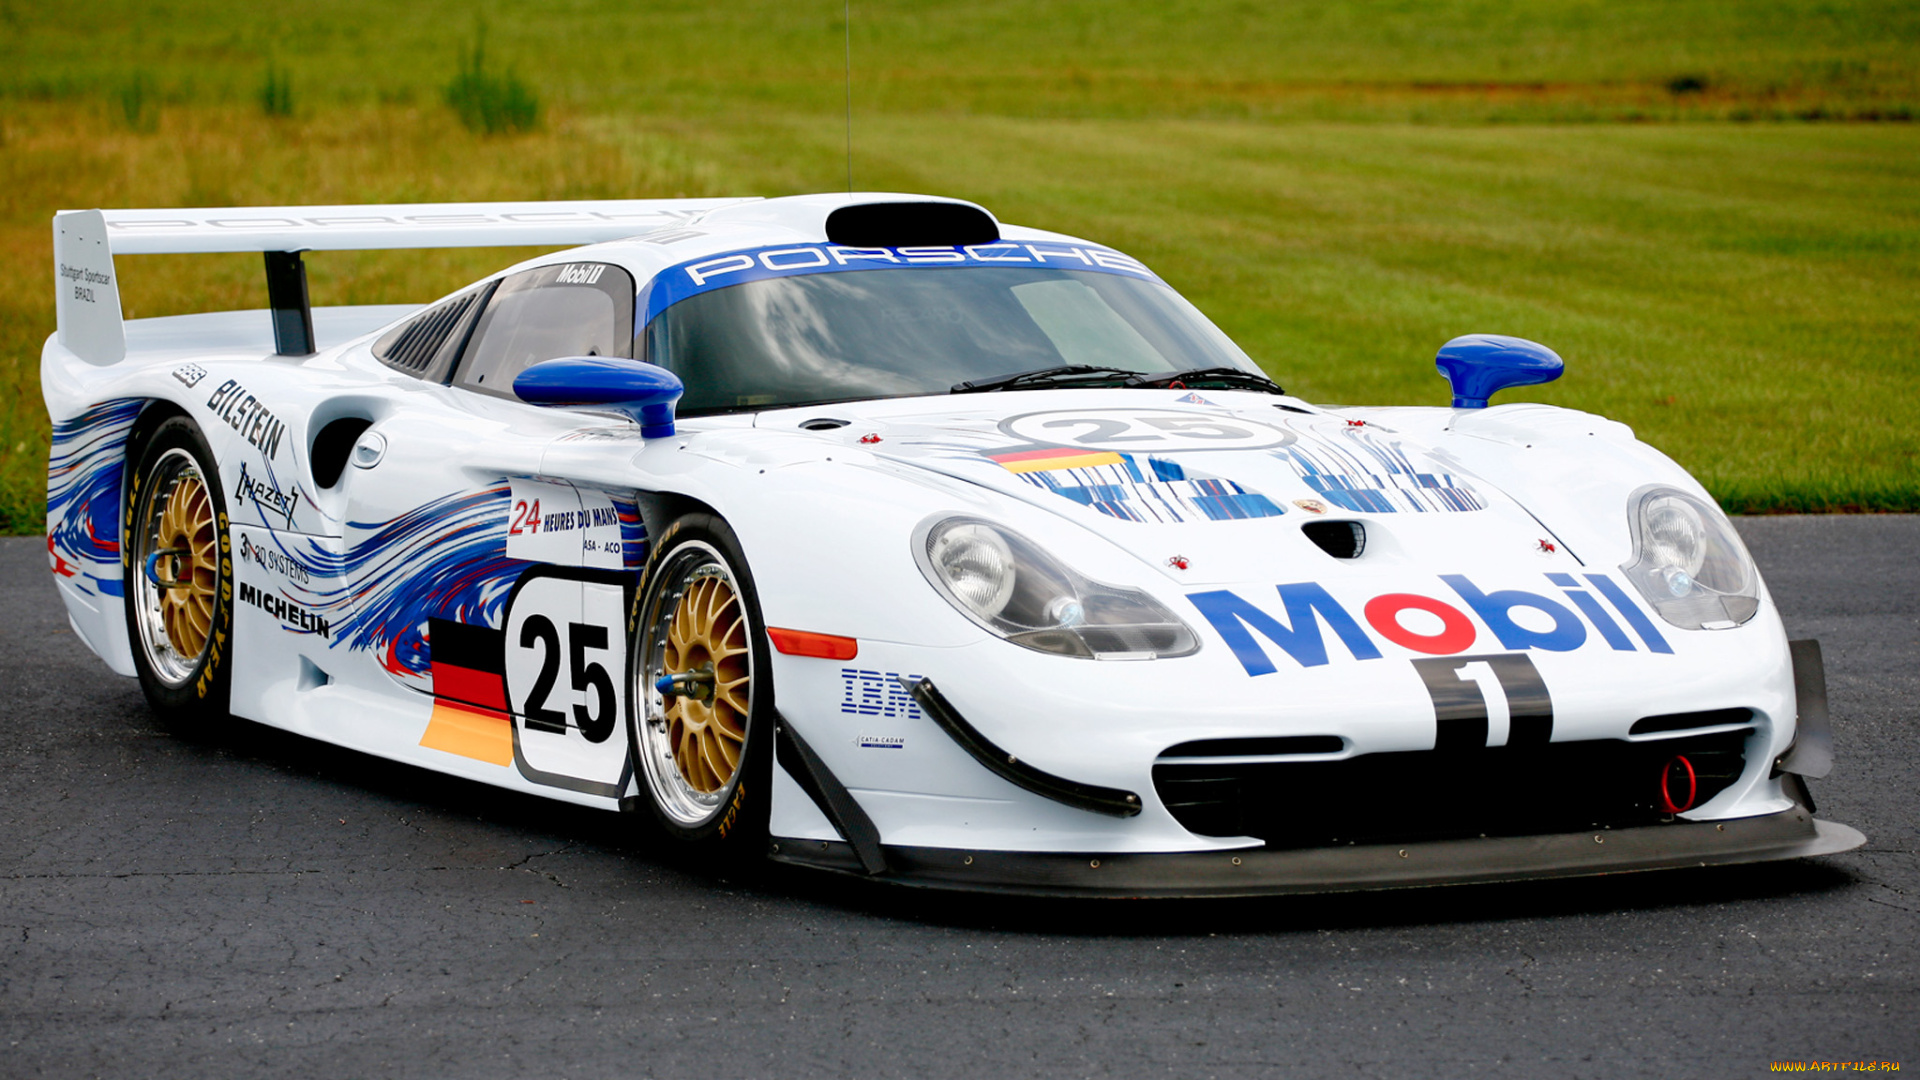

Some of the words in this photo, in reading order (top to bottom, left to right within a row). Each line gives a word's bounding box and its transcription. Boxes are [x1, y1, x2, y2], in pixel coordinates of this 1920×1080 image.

[61, 263, 83, 282] Stuttgart
[85, 267, 110, 285] Sportscar
[685, 243, 1154, 287] PORSCHE
[75, 286, 95, 303] BRAZIL
[207, 379, 285, 461] BILSTEIN
[1042, 417, 1254, 443] 25
[243, 476, 291, 509] HAZET
[508, 498, 541, 536] 24
[543, 511, 574, 533] HEURES
[577, 509, 591, 530] DU
[593, 506, 617, 528] MANS
[583, 540, 596, 551] ASA
[604, 542, 620, 554] ACO
[268, 551, 309, 584] SYSTEMS
[240, 582, 329, 639] MICHELIN
[1185, 573, 1675, 677] Mobil
[520, 613, 617, 744] 25
[841, 668, 923, 719] IBM
